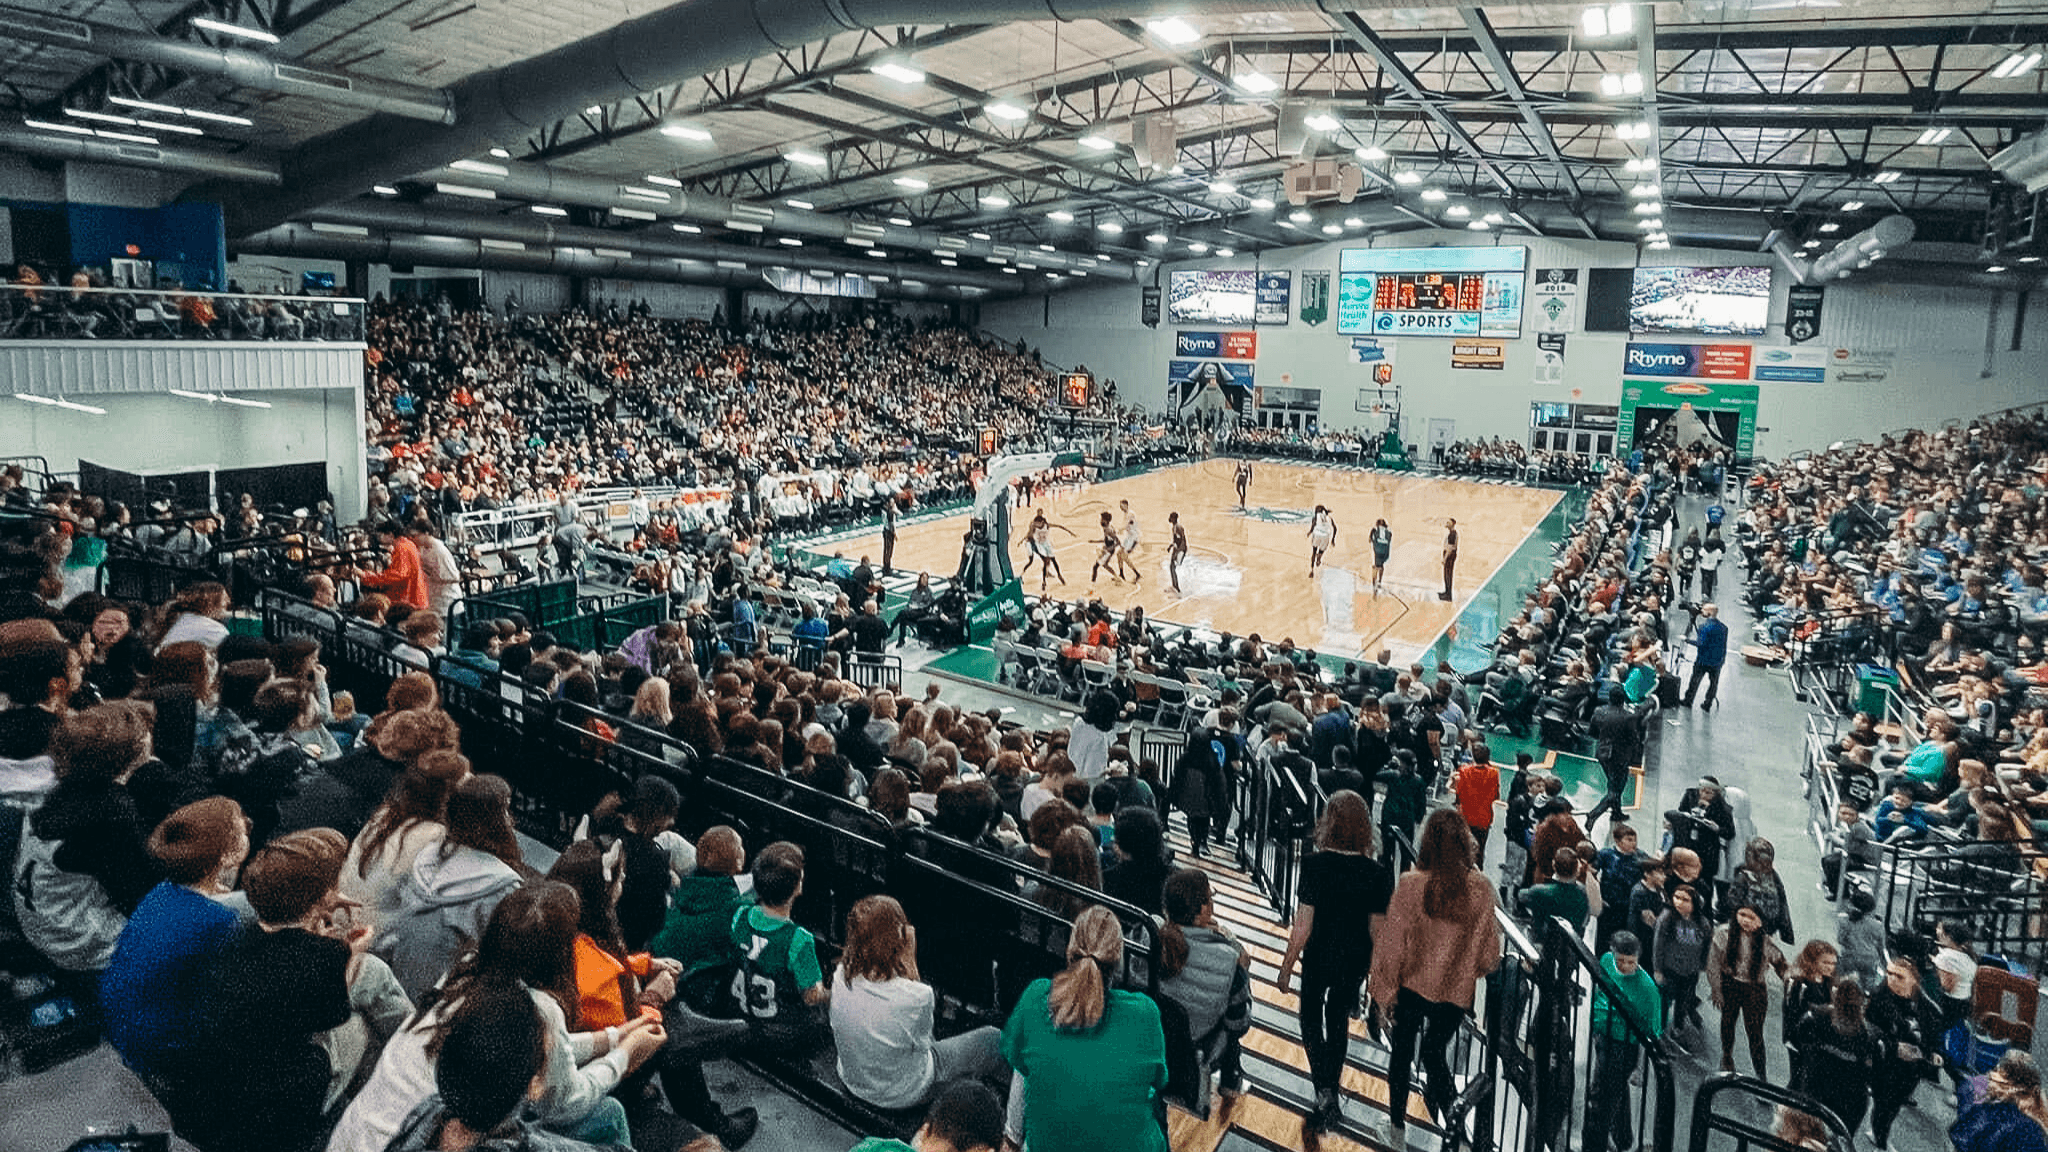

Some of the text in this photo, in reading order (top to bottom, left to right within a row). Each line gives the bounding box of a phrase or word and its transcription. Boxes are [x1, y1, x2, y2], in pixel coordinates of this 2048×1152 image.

[1399, 314, 1453, 328] SPORTS
[1178, 336, 1216, 351] Rhyme
[1629, 349, 1686, 368] Rhyme
[731, 968, 778, 1018] 43
